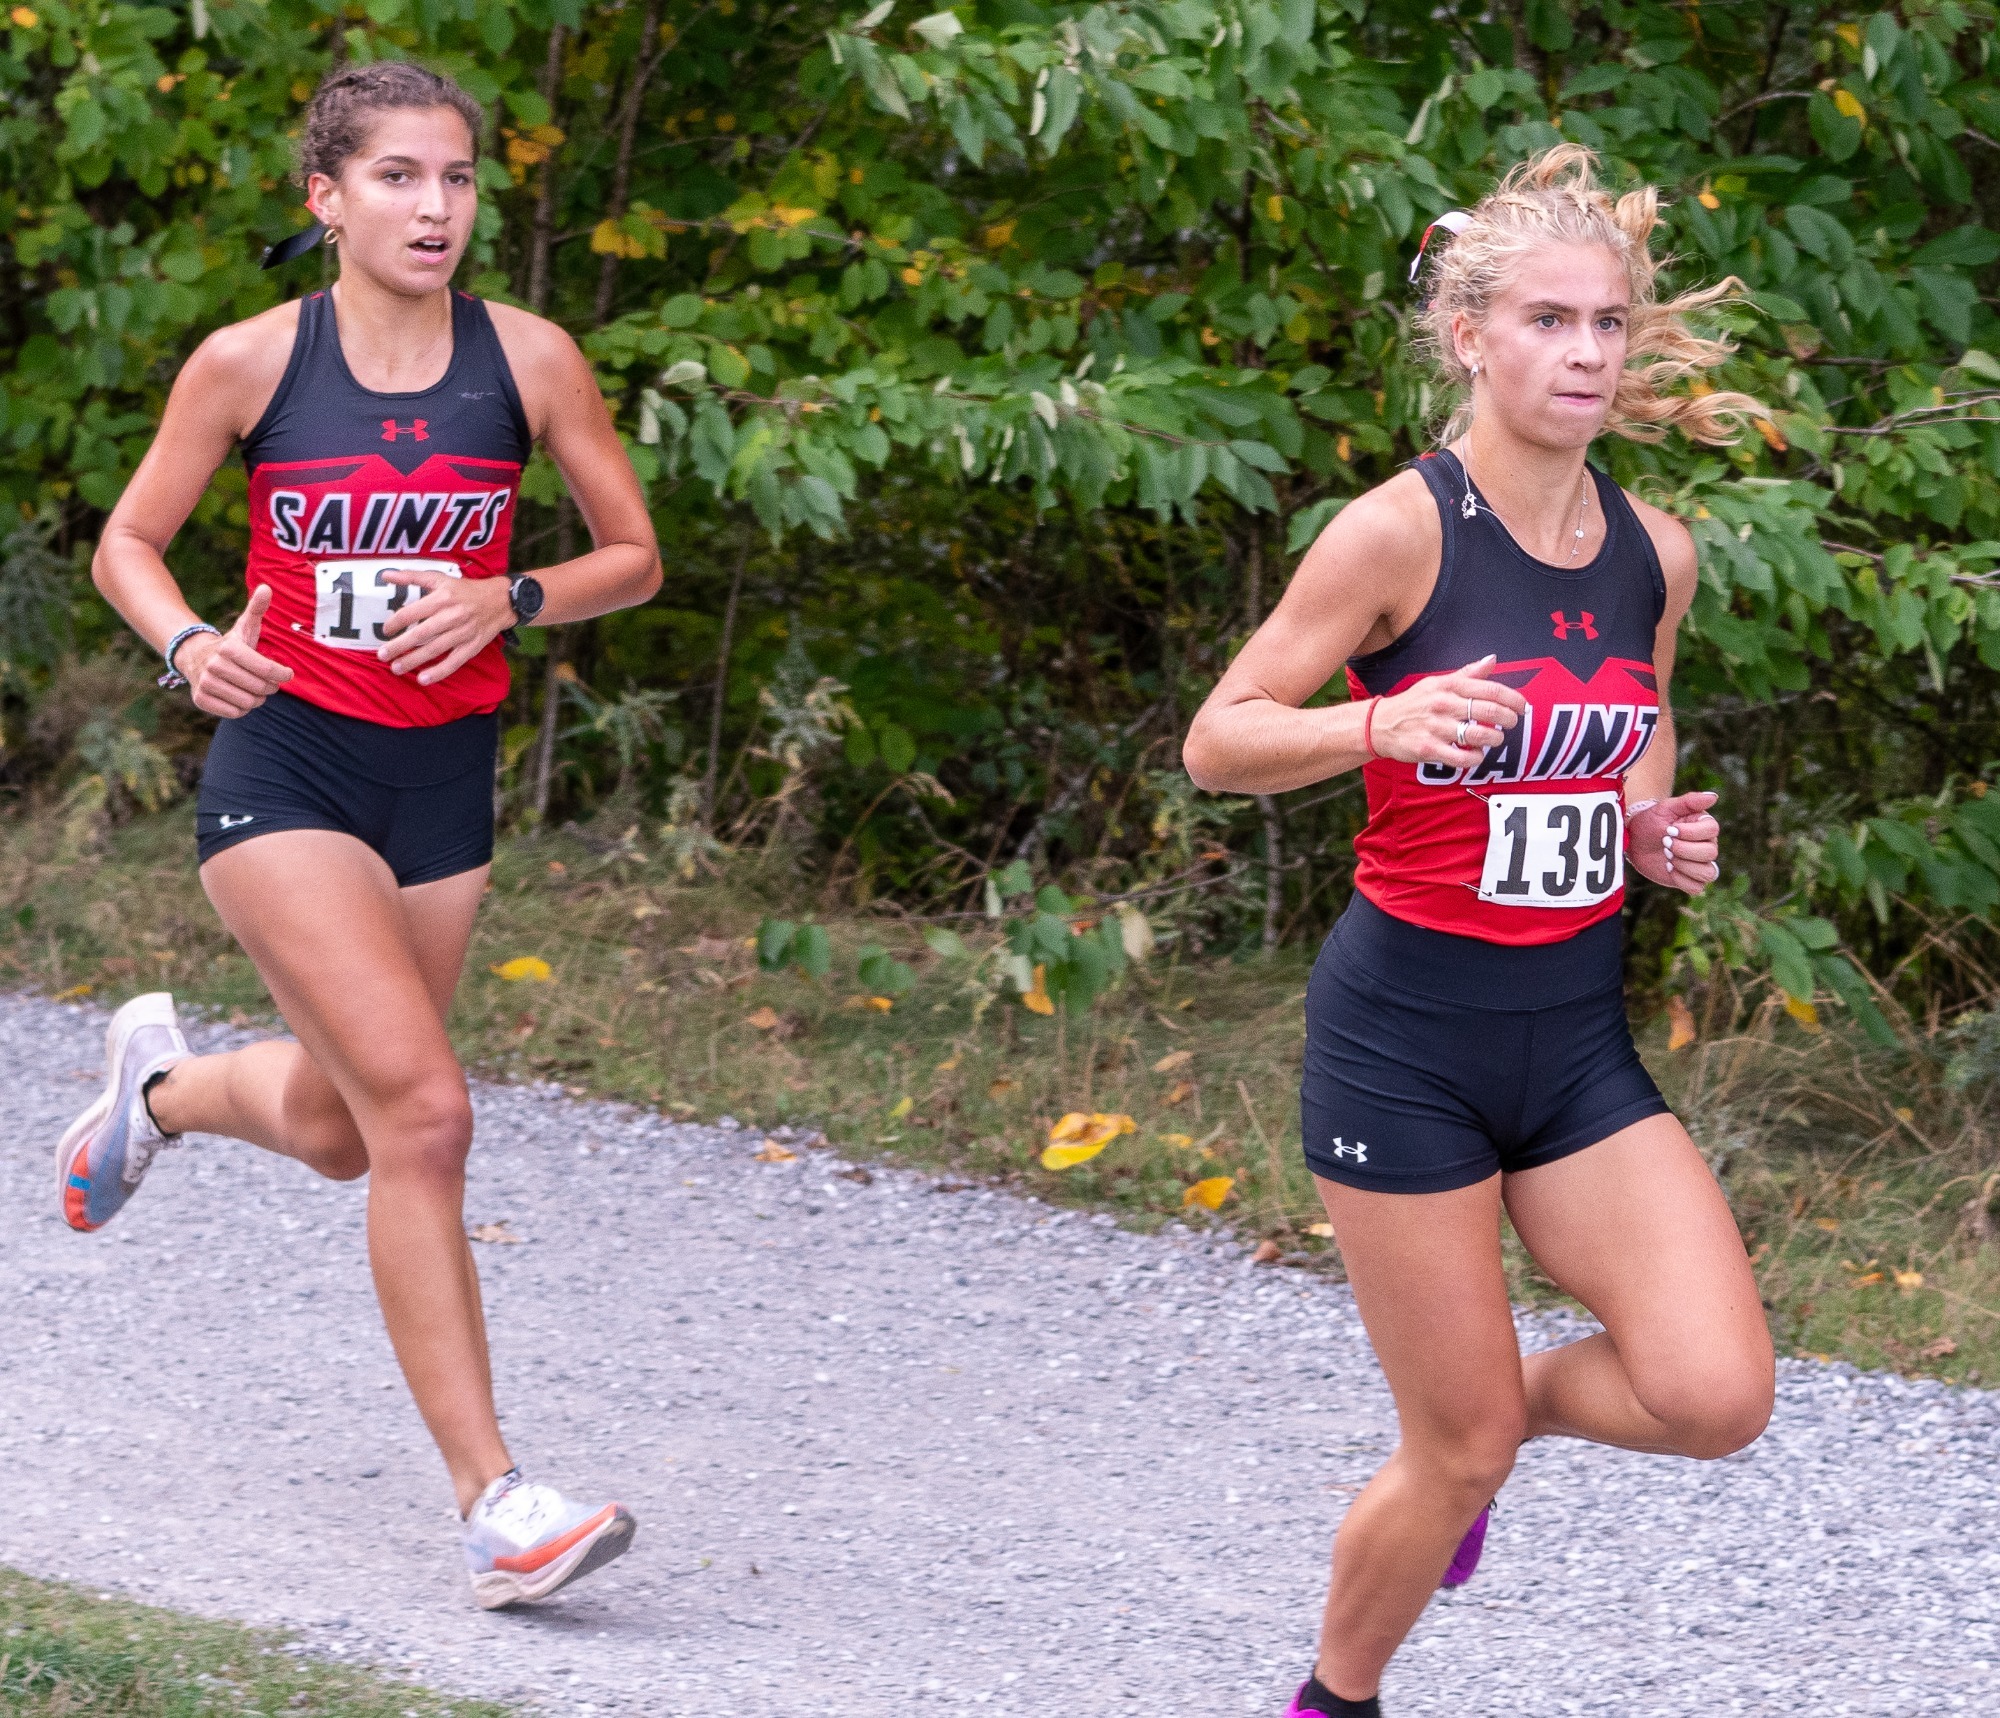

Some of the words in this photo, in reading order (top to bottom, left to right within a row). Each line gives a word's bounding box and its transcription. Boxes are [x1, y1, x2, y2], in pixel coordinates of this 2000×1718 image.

[269, 489, 511, 554] SAINTS
[329, 567, 449, 641] 13
[1495, 802, 1618, 897] 139
